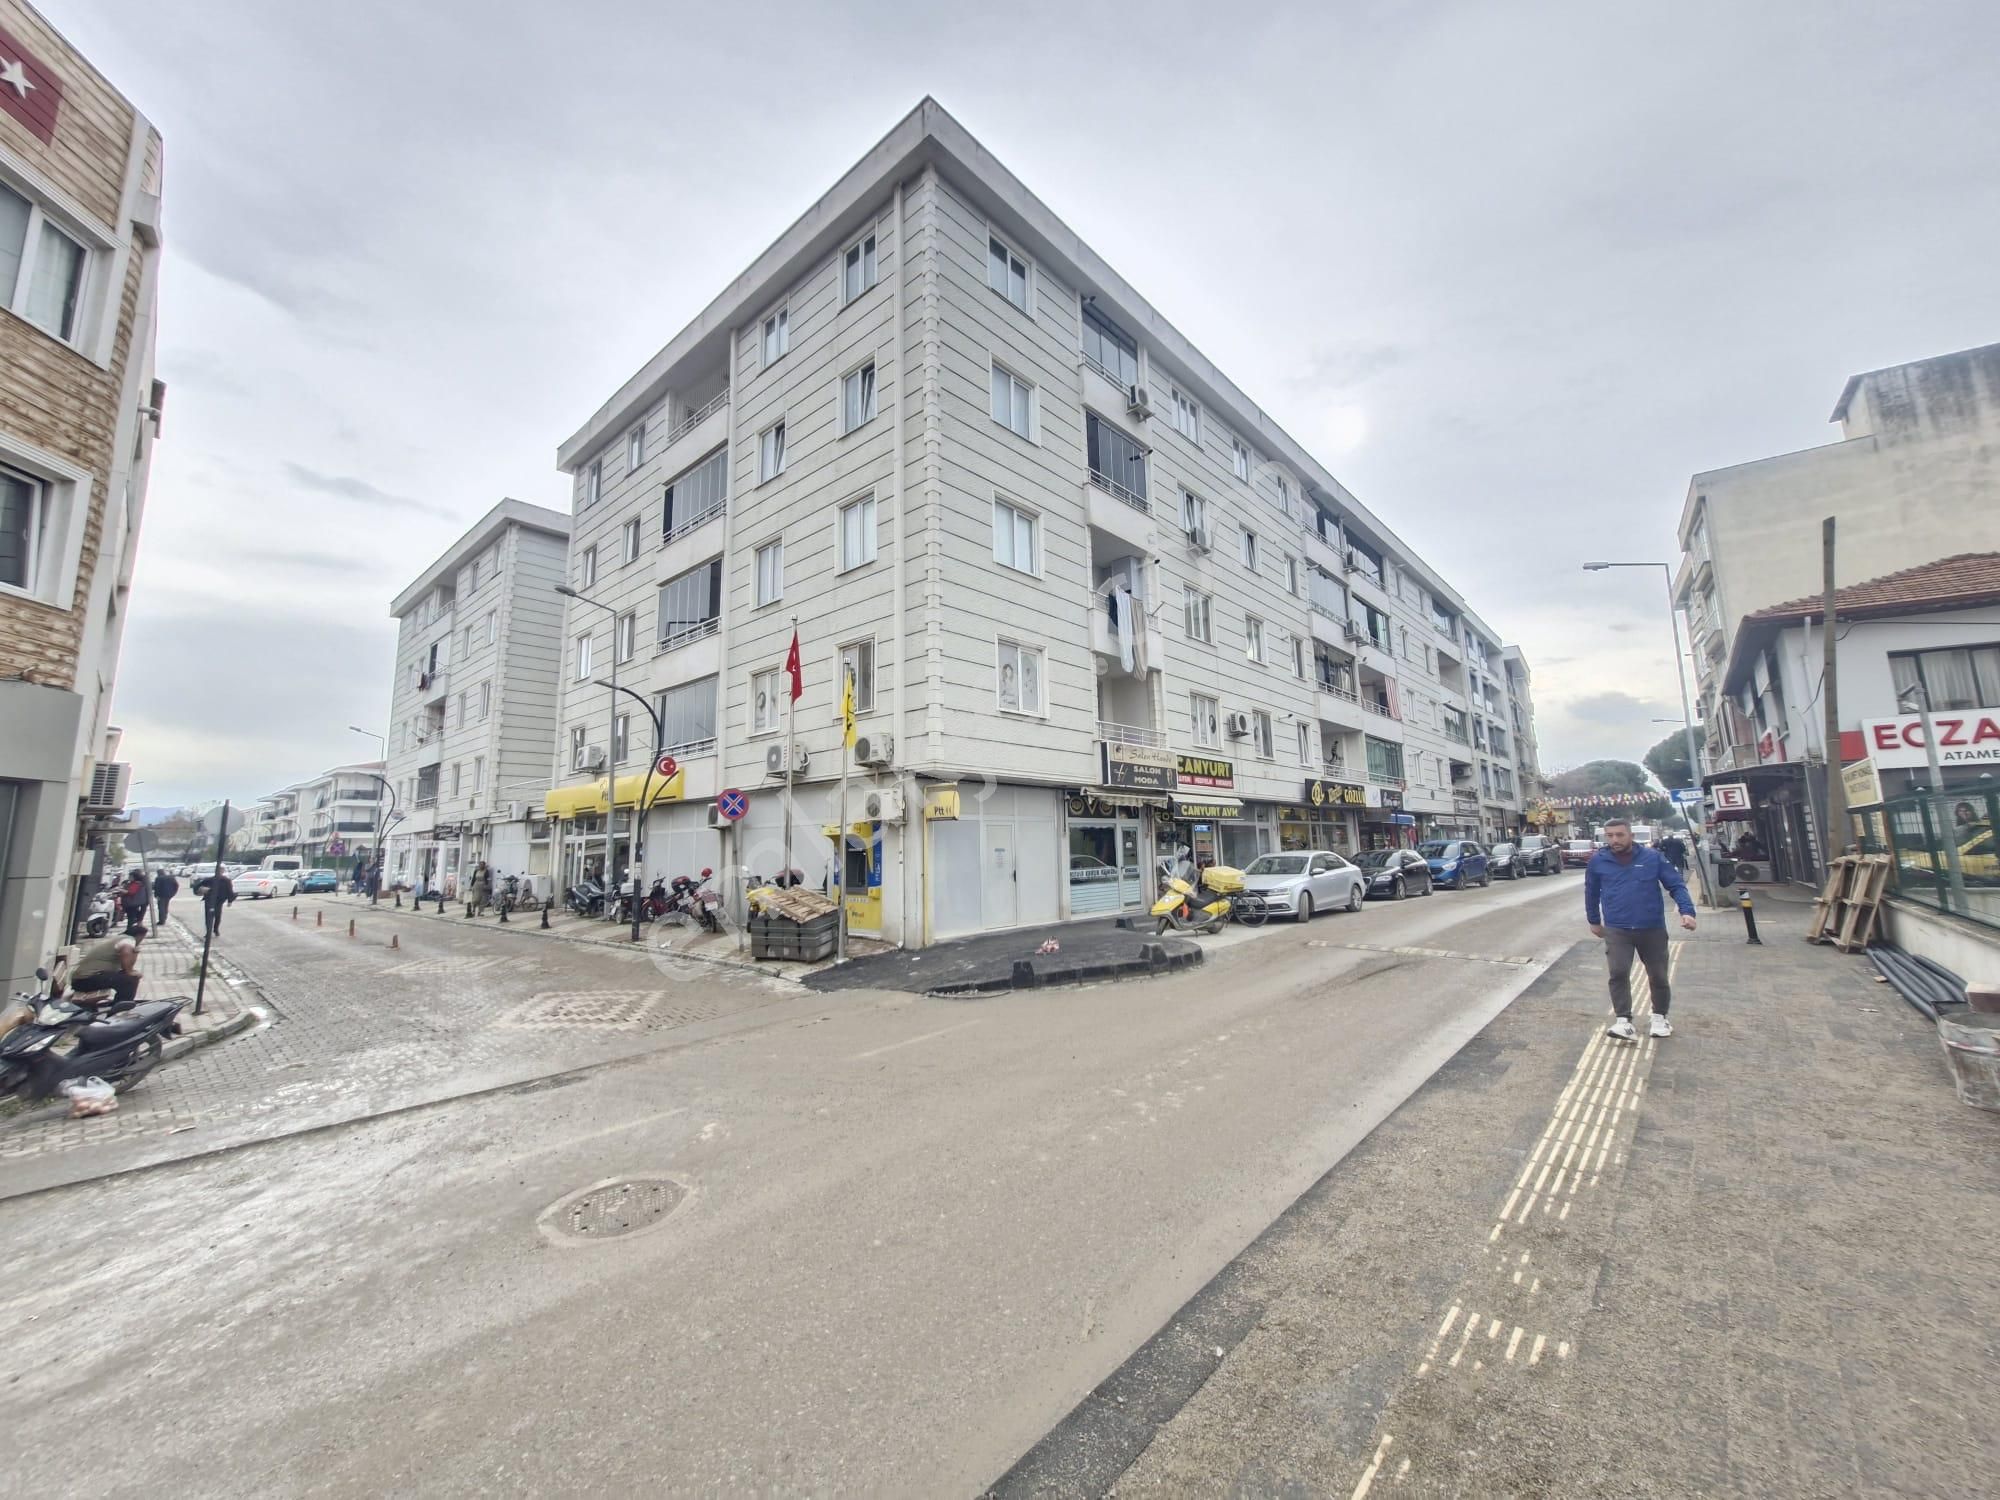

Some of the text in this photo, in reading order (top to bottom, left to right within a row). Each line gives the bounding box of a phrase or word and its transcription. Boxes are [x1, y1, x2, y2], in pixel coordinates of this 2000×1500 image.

[1873, 717, 2000, 750] ECZA
[1133, 765, 1161, 775] SALON
[1177, 756, 1230, 777] CANYURT
[1134, 776, 1159, 785] MODA
[1723, 790, 1738, 805] E
[1181, 804, 1220, 817] CANYURT
